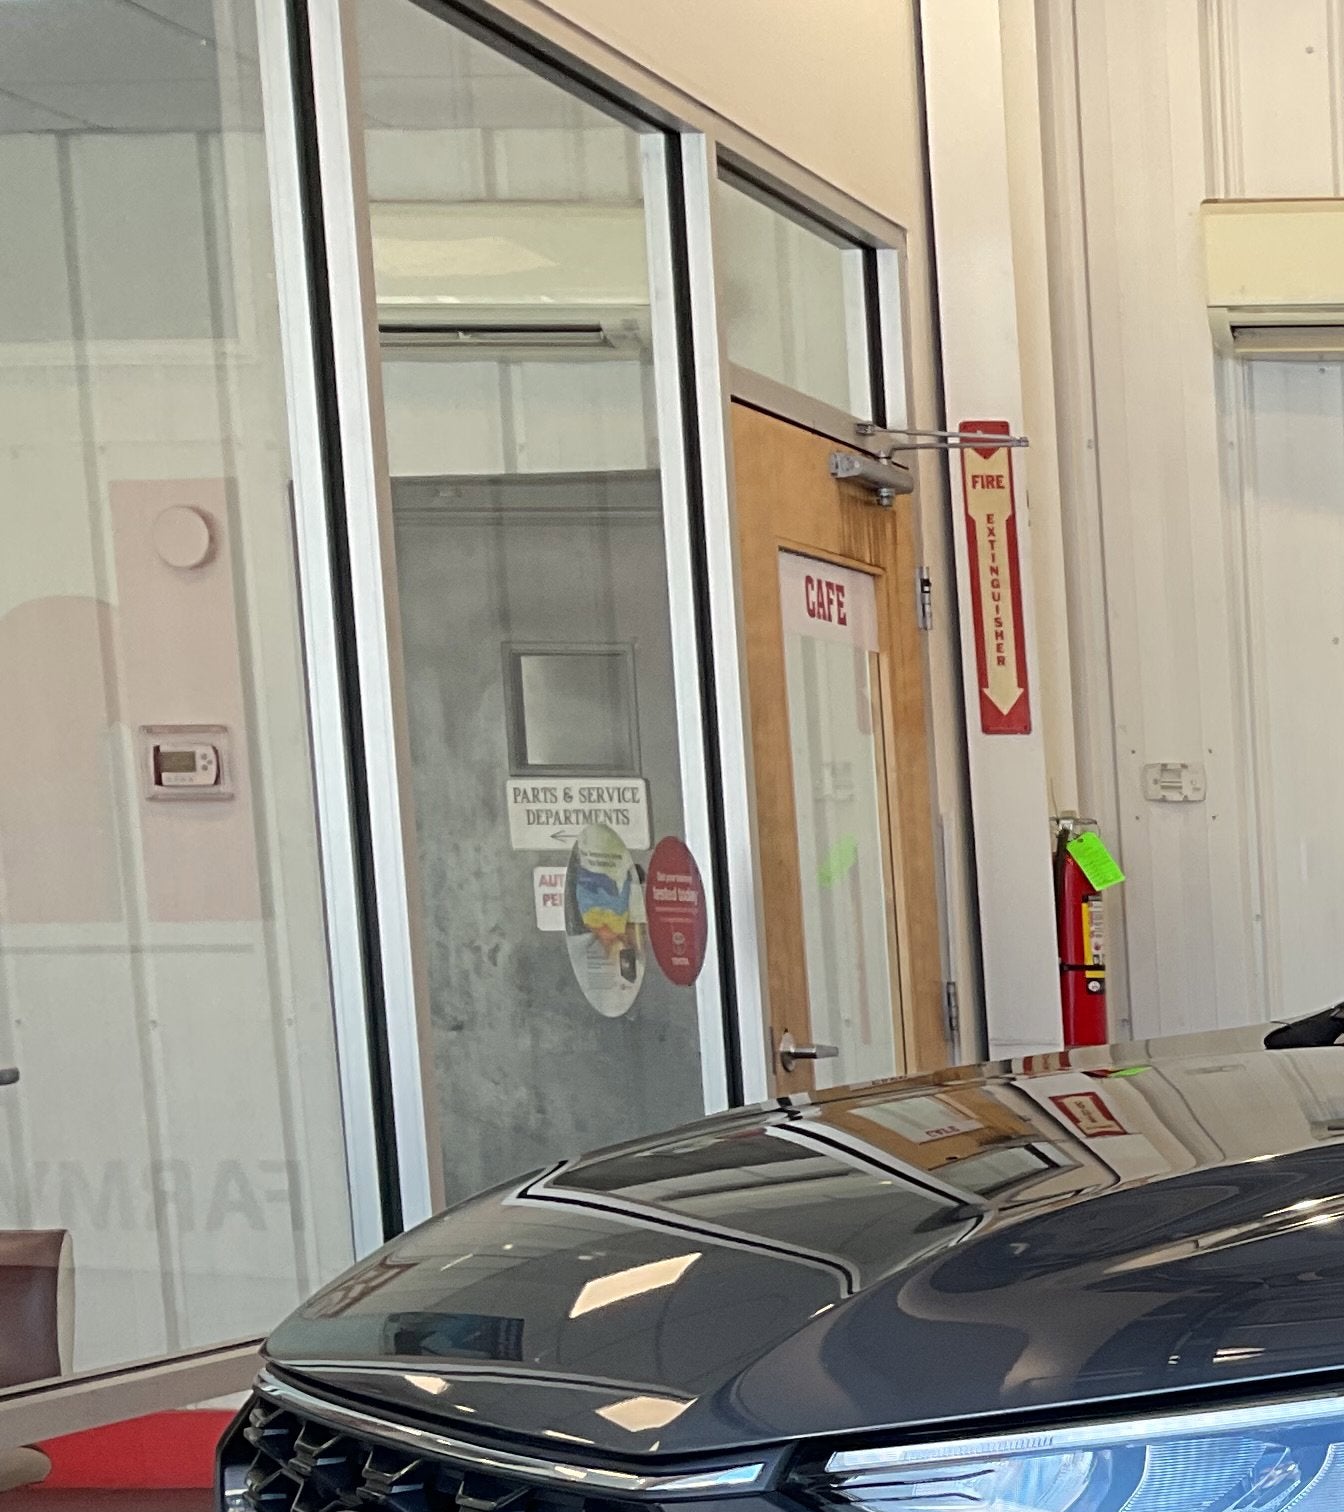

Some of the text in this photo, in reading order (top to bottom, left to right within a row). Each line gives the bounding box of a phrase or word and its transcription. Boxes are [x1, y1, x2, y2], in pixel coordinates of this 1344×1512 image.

[971, 474, 1005, 490] FIRE
[986, 513, 1006, 667] EXTINGUISHER
[804, 575, 847, 626] CAFE
[513, 787, 640, 804] PARTS & SERVICE
[526, 808, 630, 826] DEPARTMENTS
